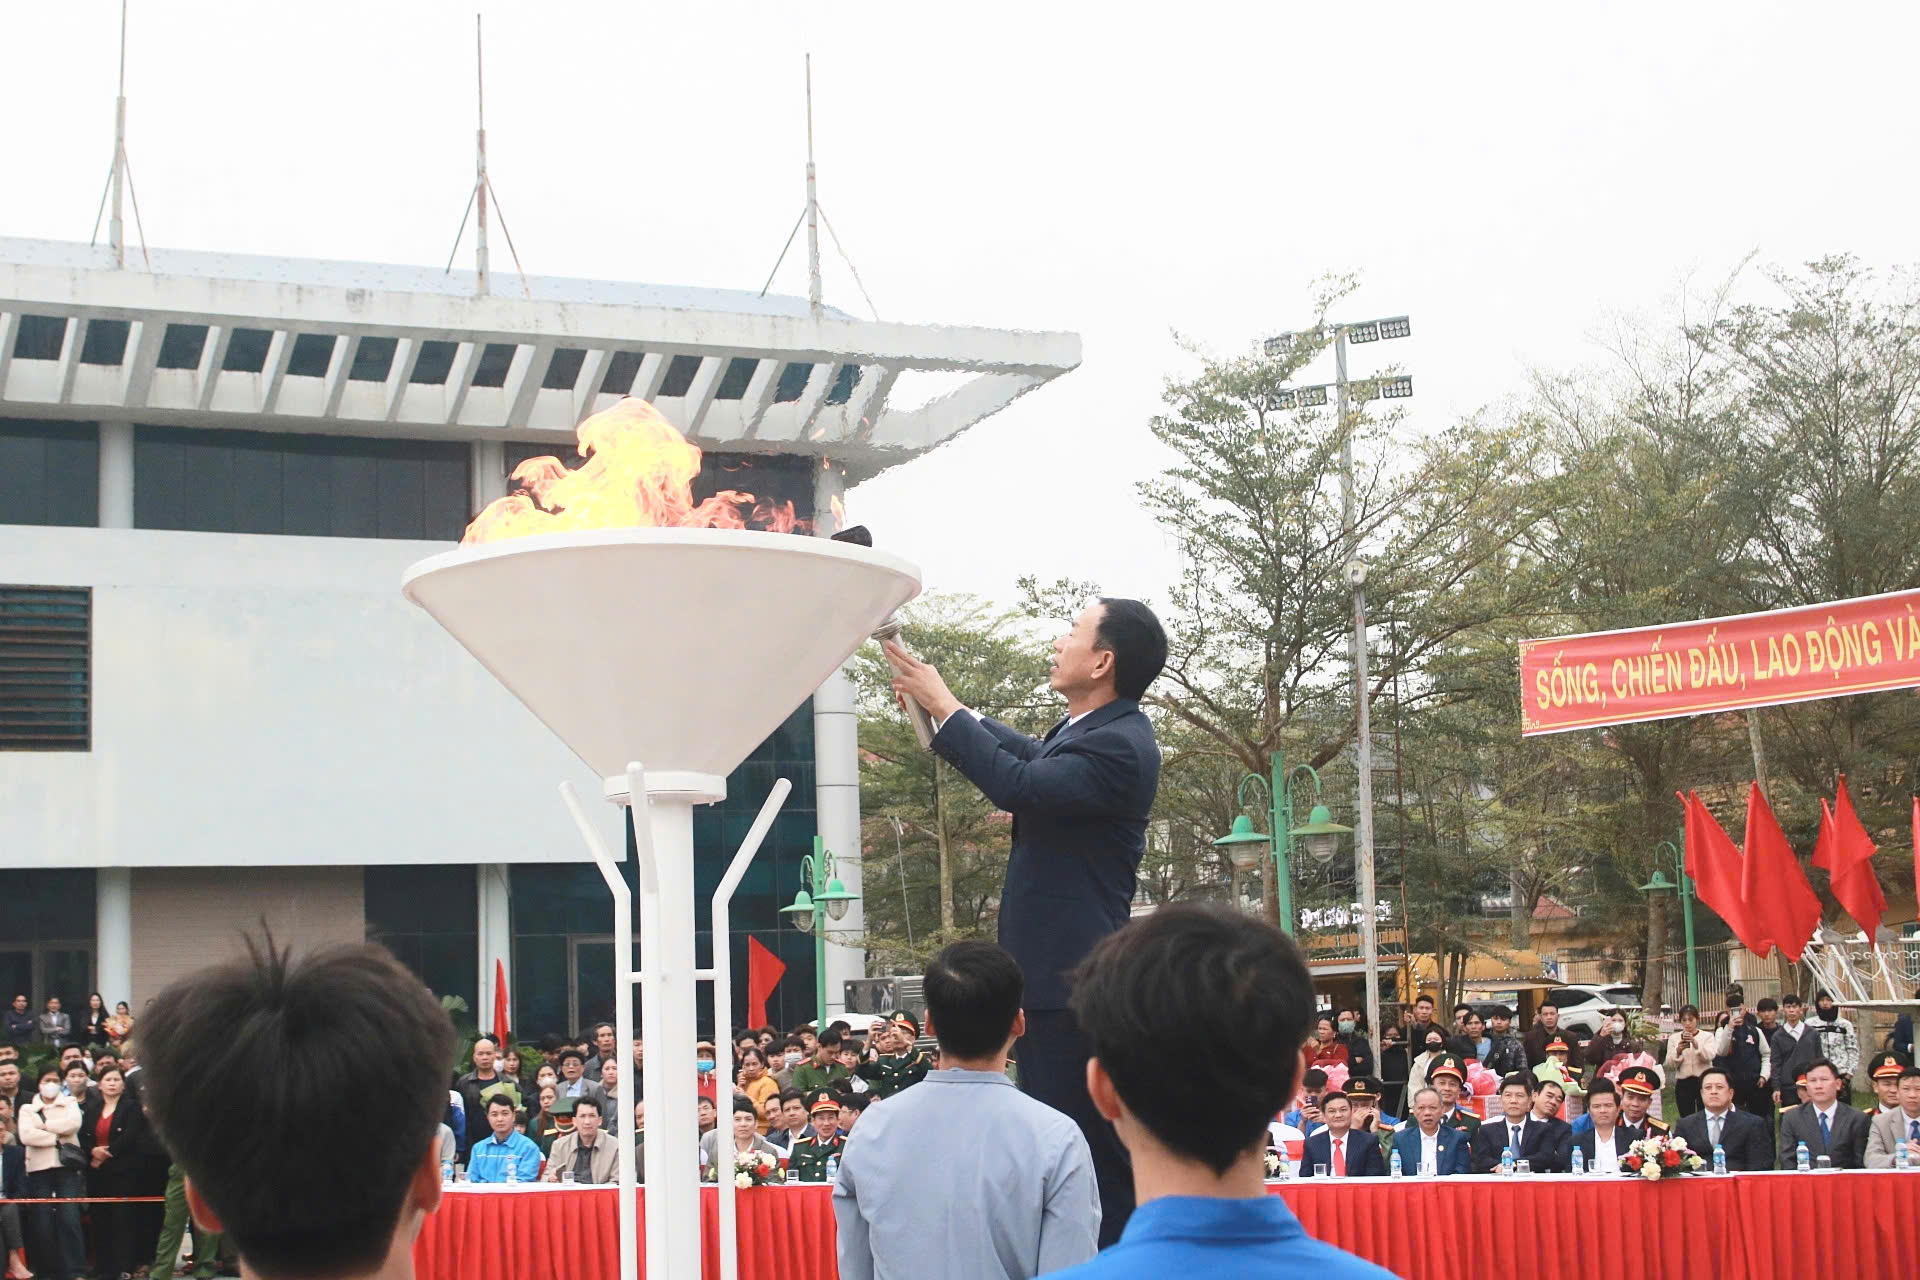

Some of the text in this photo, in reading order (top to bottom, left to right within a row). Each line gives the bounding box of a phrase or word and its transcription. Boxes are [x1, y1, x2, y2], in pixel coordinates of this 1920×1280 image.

[1536, 603, 1920, 710] SỐNG, CHIẾN ĐẤU, LAO ĐỘNG VÀ
